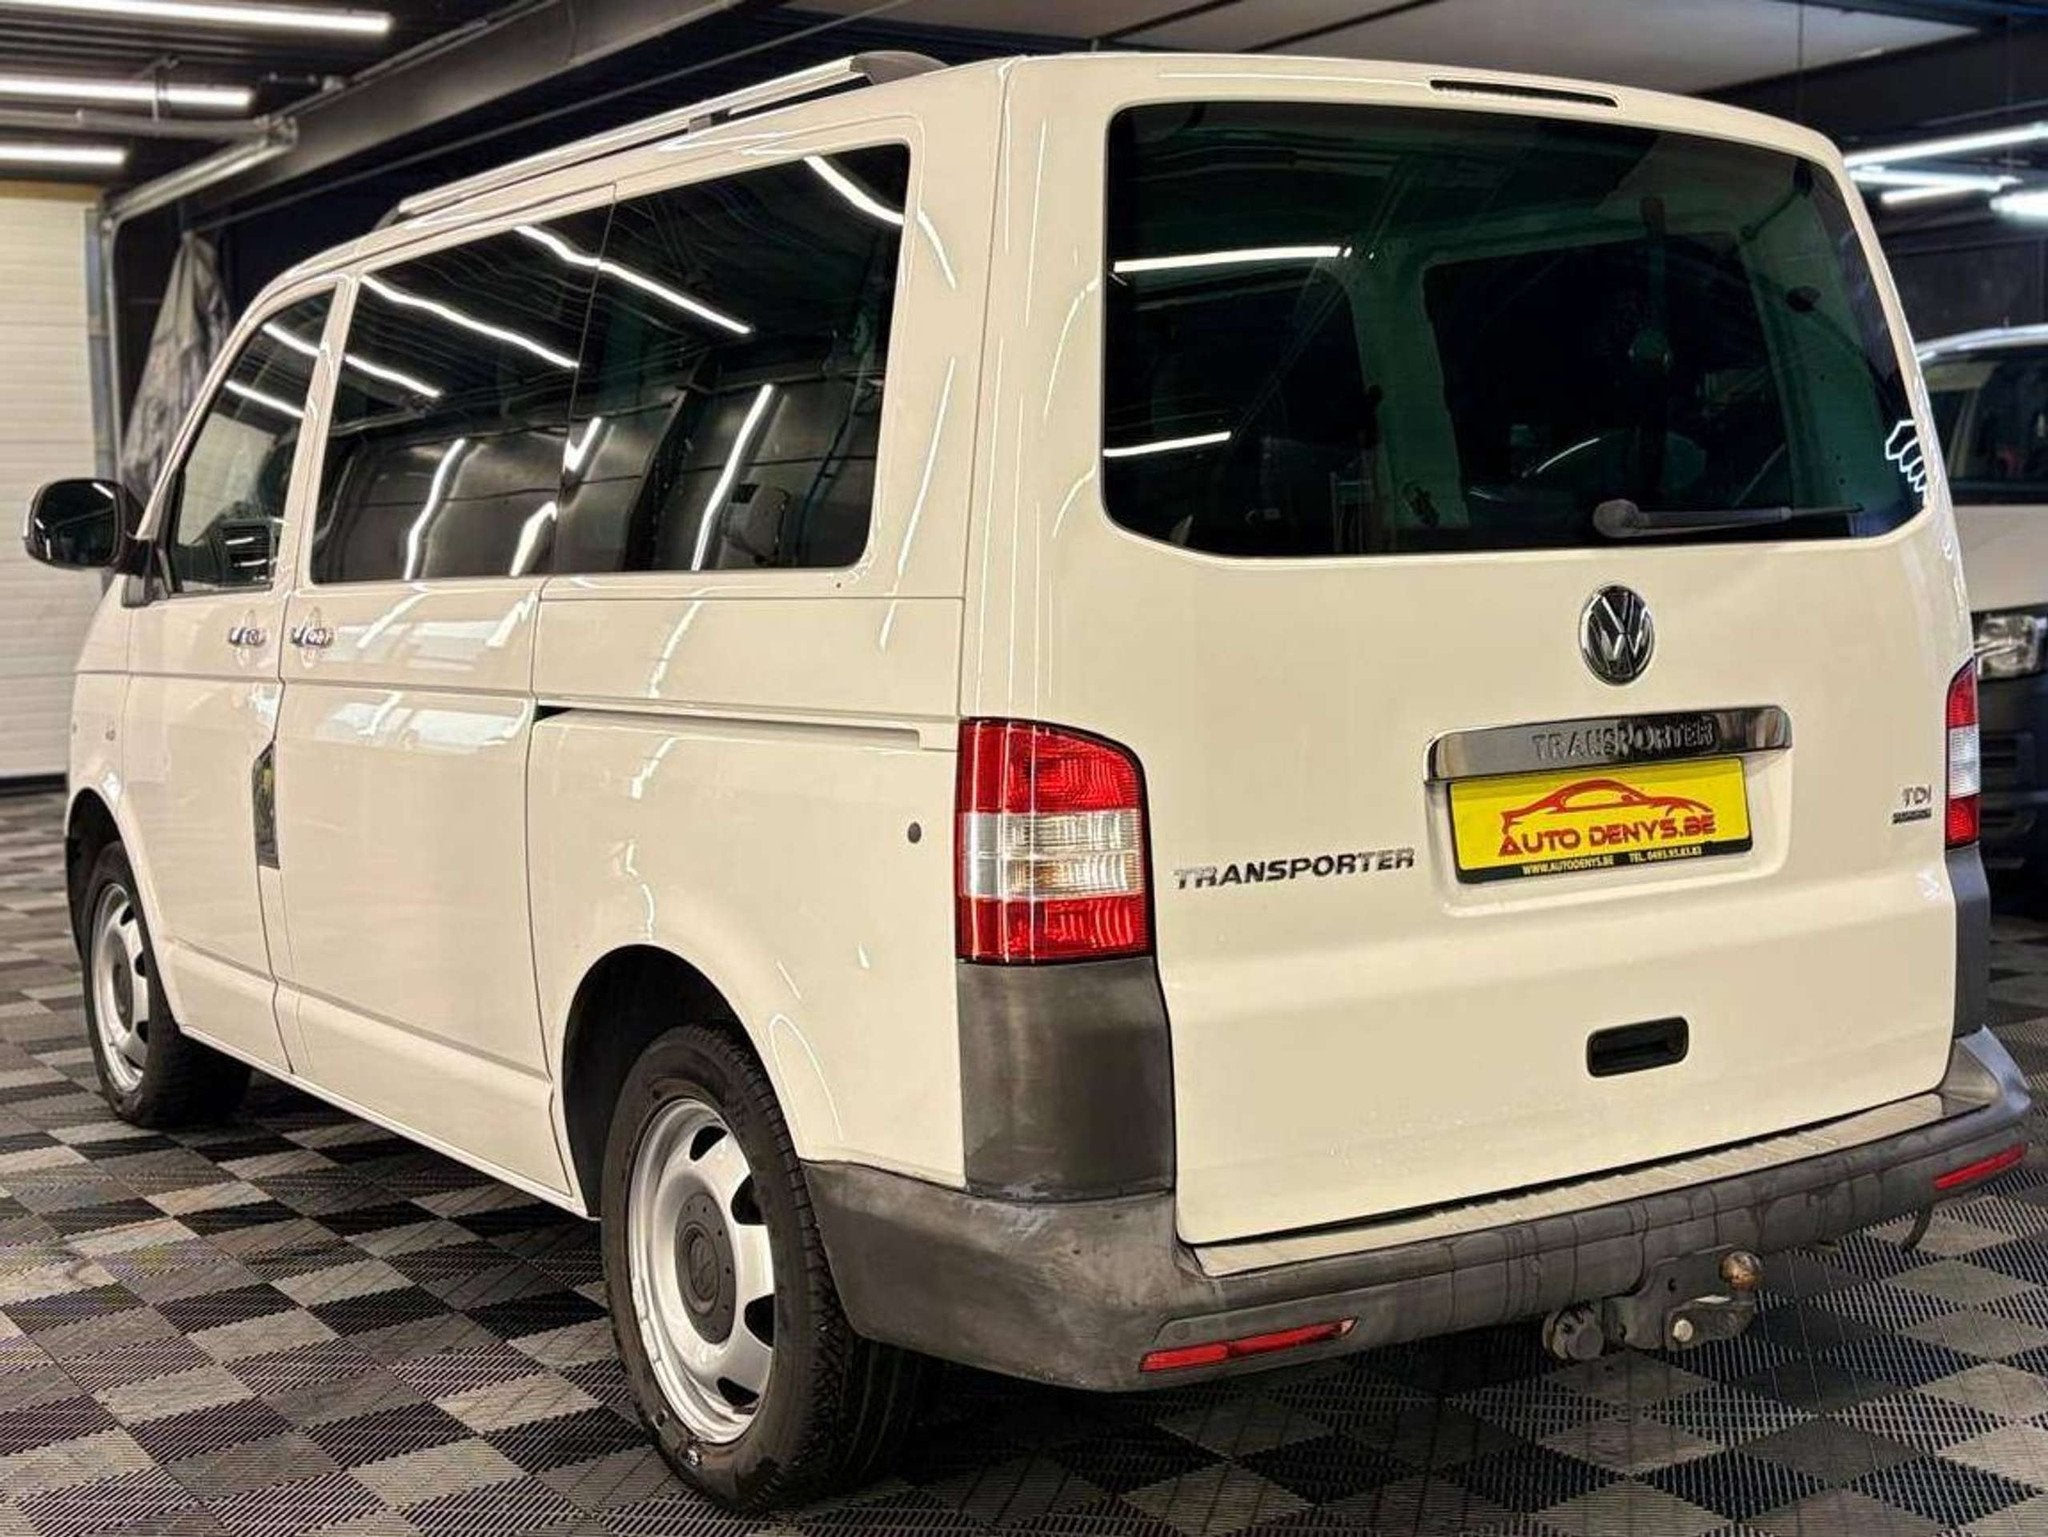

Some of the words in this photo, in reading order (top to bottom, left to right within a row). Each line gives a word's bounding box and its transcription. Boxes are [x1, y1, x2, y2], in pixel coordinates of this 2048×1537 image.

[1531, 719, 1715, 760] TRANSPORTER
[1902, 784, 1932, 807] TDI
[1498, 828, 1581, 857] AUTO
[1588, 814, 1716, 847] DENYS.BE
[1173, 847, 1415, 890] TRANSPORTER
[1522, 855, 1614, 875] WWW.AUTODENYS.BE
